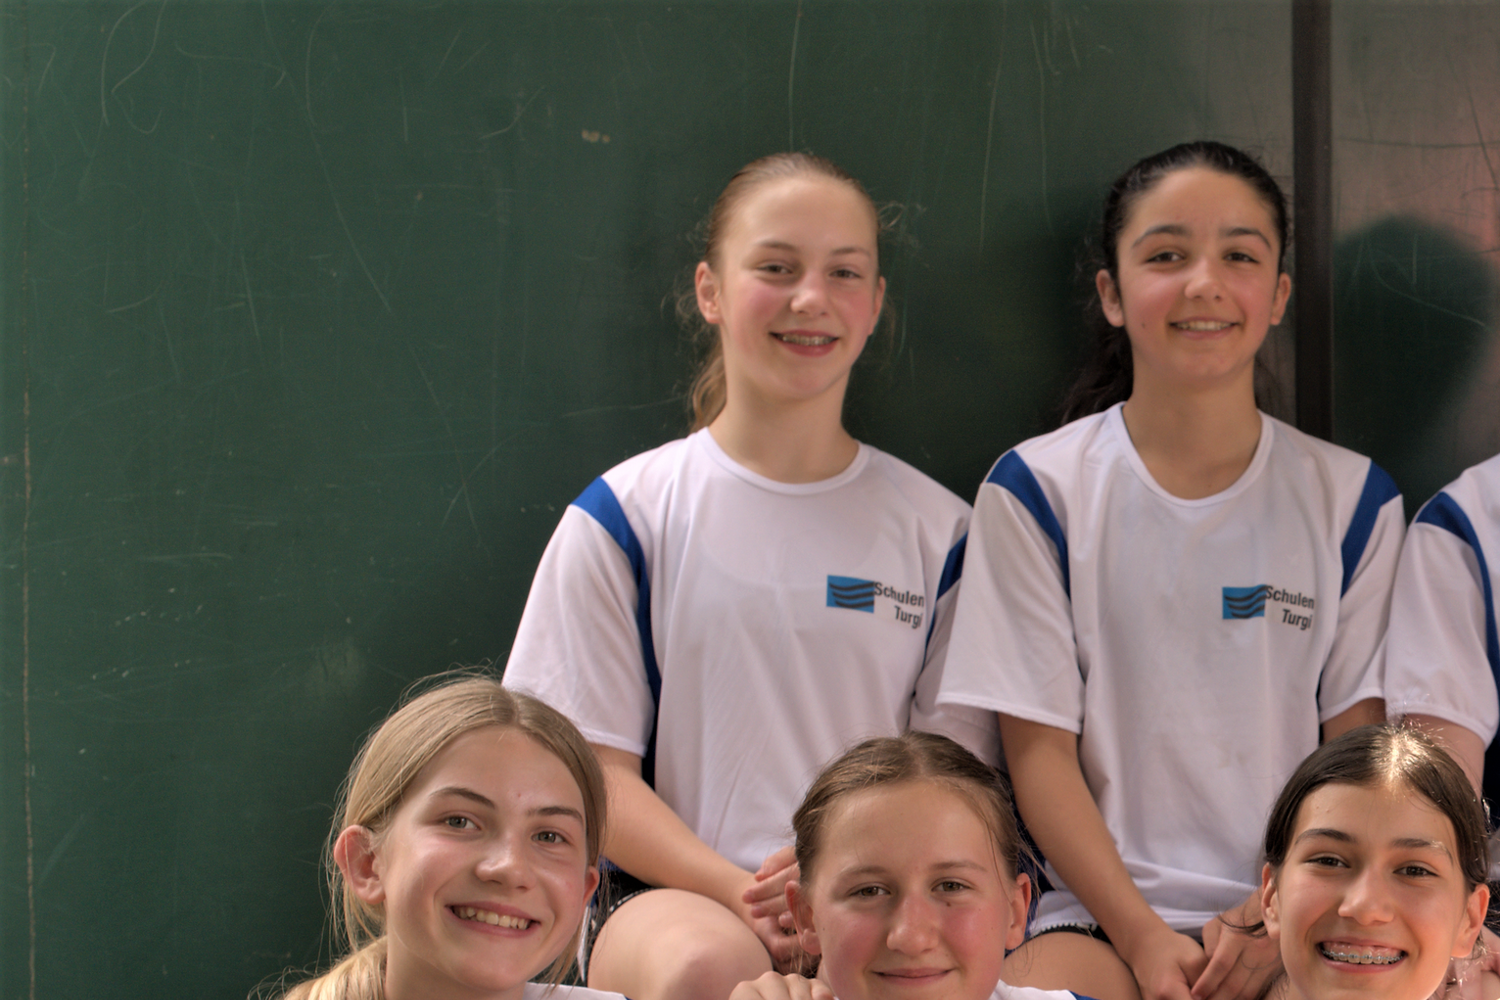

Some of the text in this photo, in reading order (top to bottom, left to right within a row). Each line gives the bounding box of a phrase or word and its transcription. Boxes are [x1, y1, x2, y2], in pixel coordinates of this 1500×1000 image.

[874, 581, 925, 608] Schulen
[1266, 585, 1315, 609] Schulen
[894, 604, 924, 629] Turgi
[1282, 608, 1313, 631] Turgi
